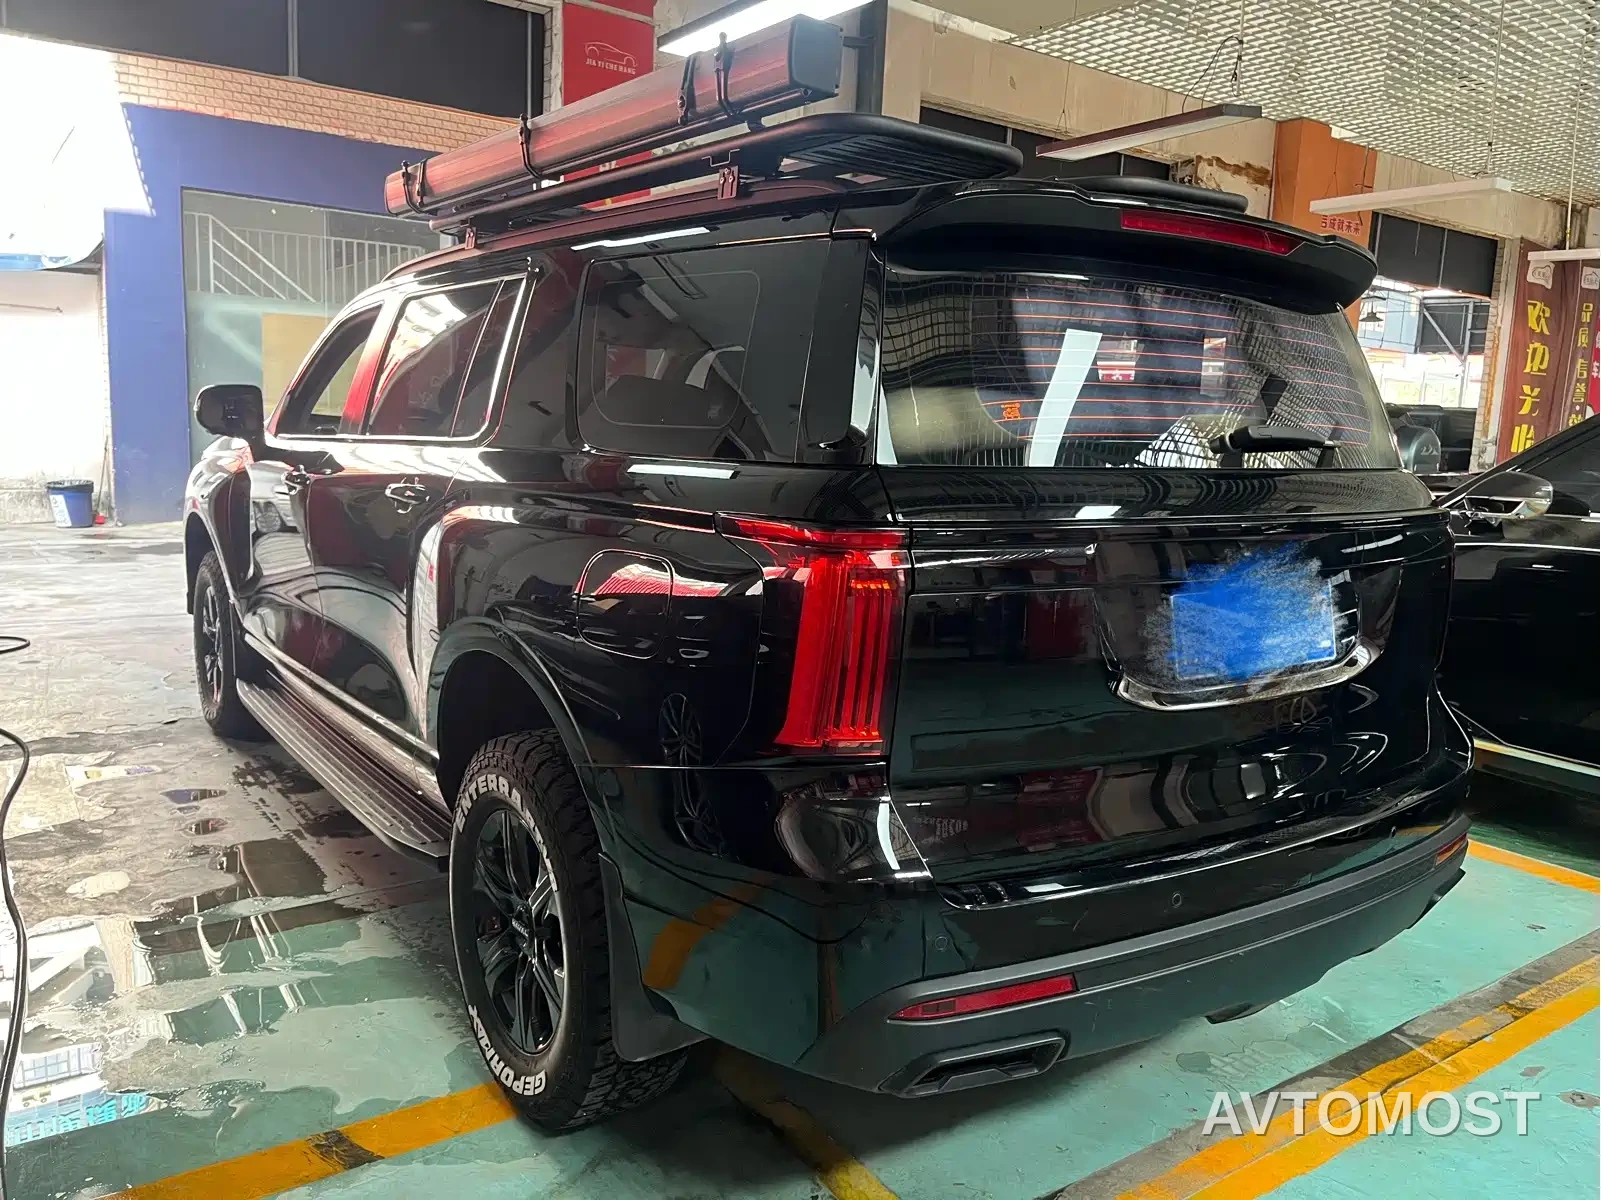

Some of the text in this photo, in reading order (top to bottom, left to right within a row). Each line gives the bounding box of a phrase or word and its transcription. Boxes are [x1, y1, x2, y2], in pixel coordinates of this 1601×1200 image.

[585, 57, 597, 67] JIA
[455, 773, 524, 833] ENTERRA
[468, 1004, 546, 1096] GEPORMAX
